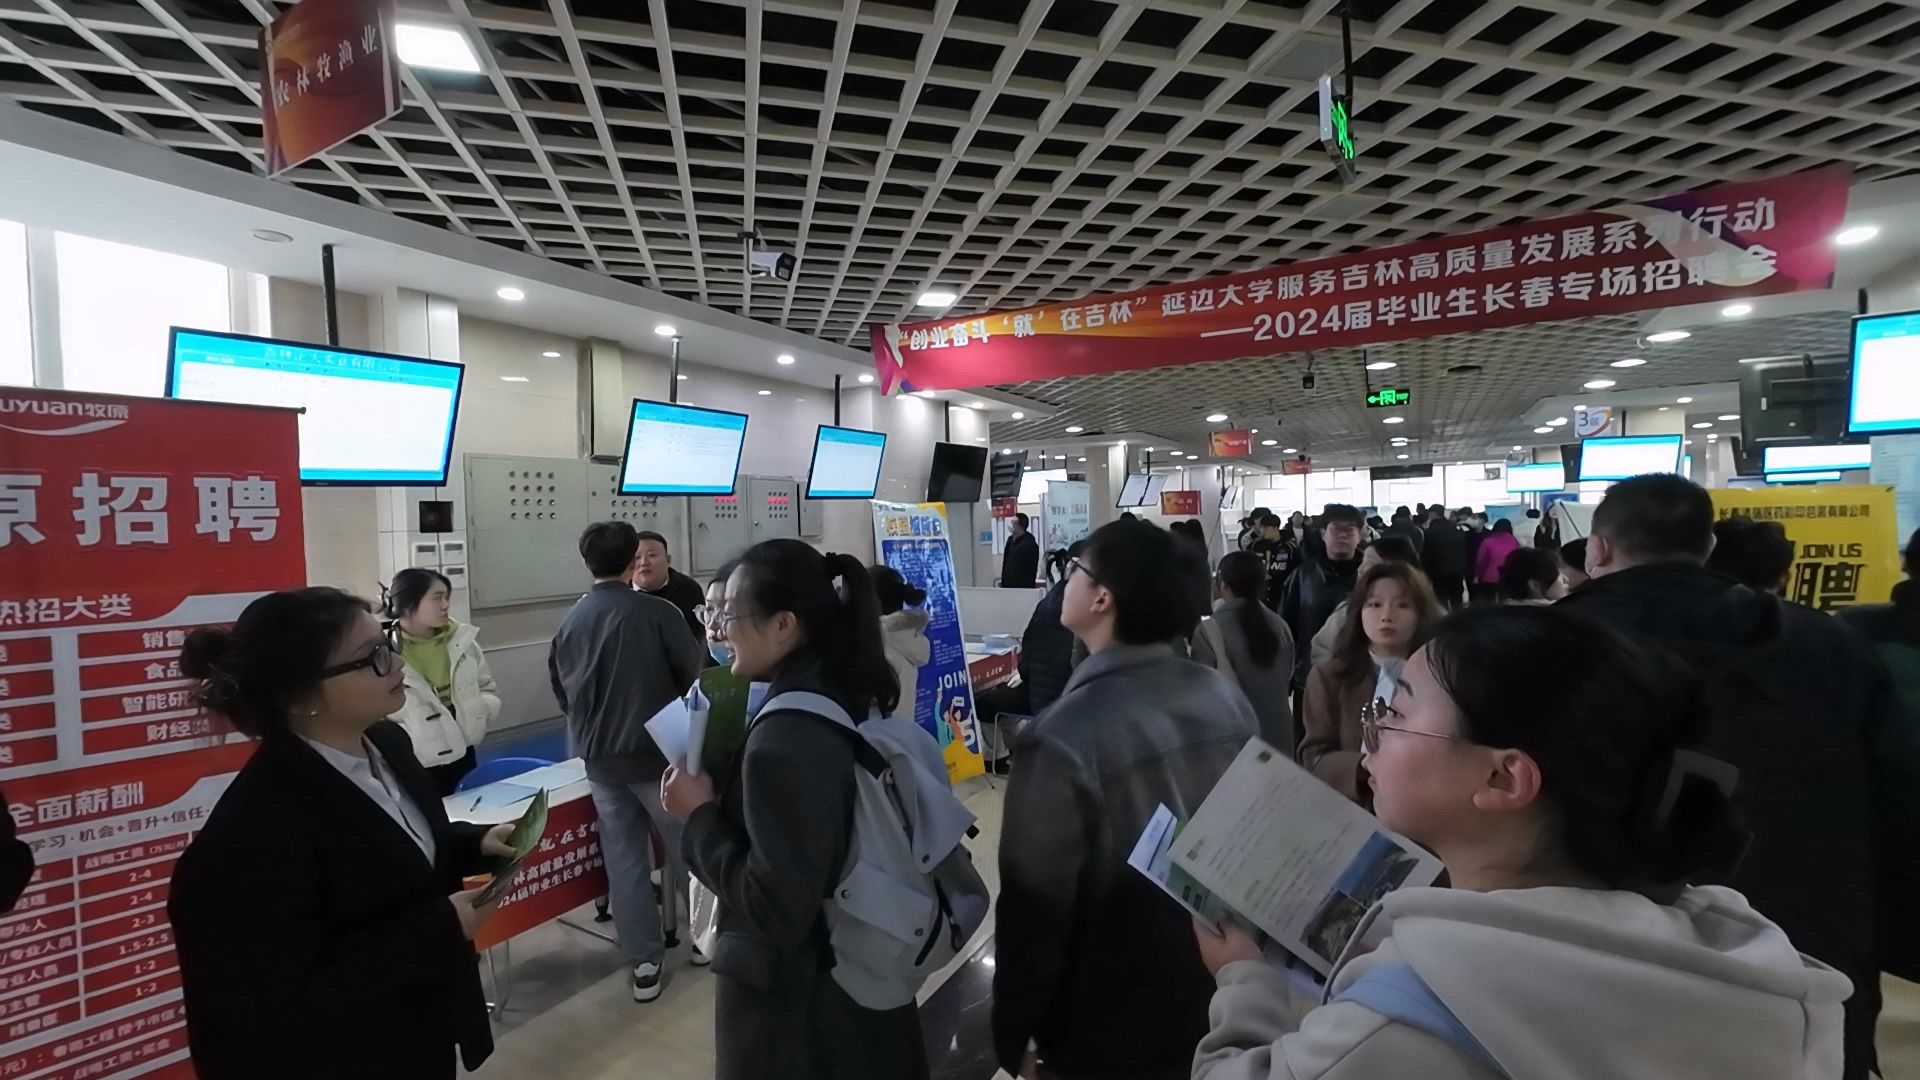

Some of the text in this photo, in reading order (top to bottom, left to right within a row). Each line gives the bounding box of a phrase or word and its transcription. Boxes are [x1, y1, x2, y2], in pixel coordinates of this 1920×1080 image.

[1578, 411, 1588, 427] 3
[1799, 543, 1862, 558] JOIN US
[937, 668, 967, 692] JOIN
[9, 781, 144, 828] 全面薪酬
